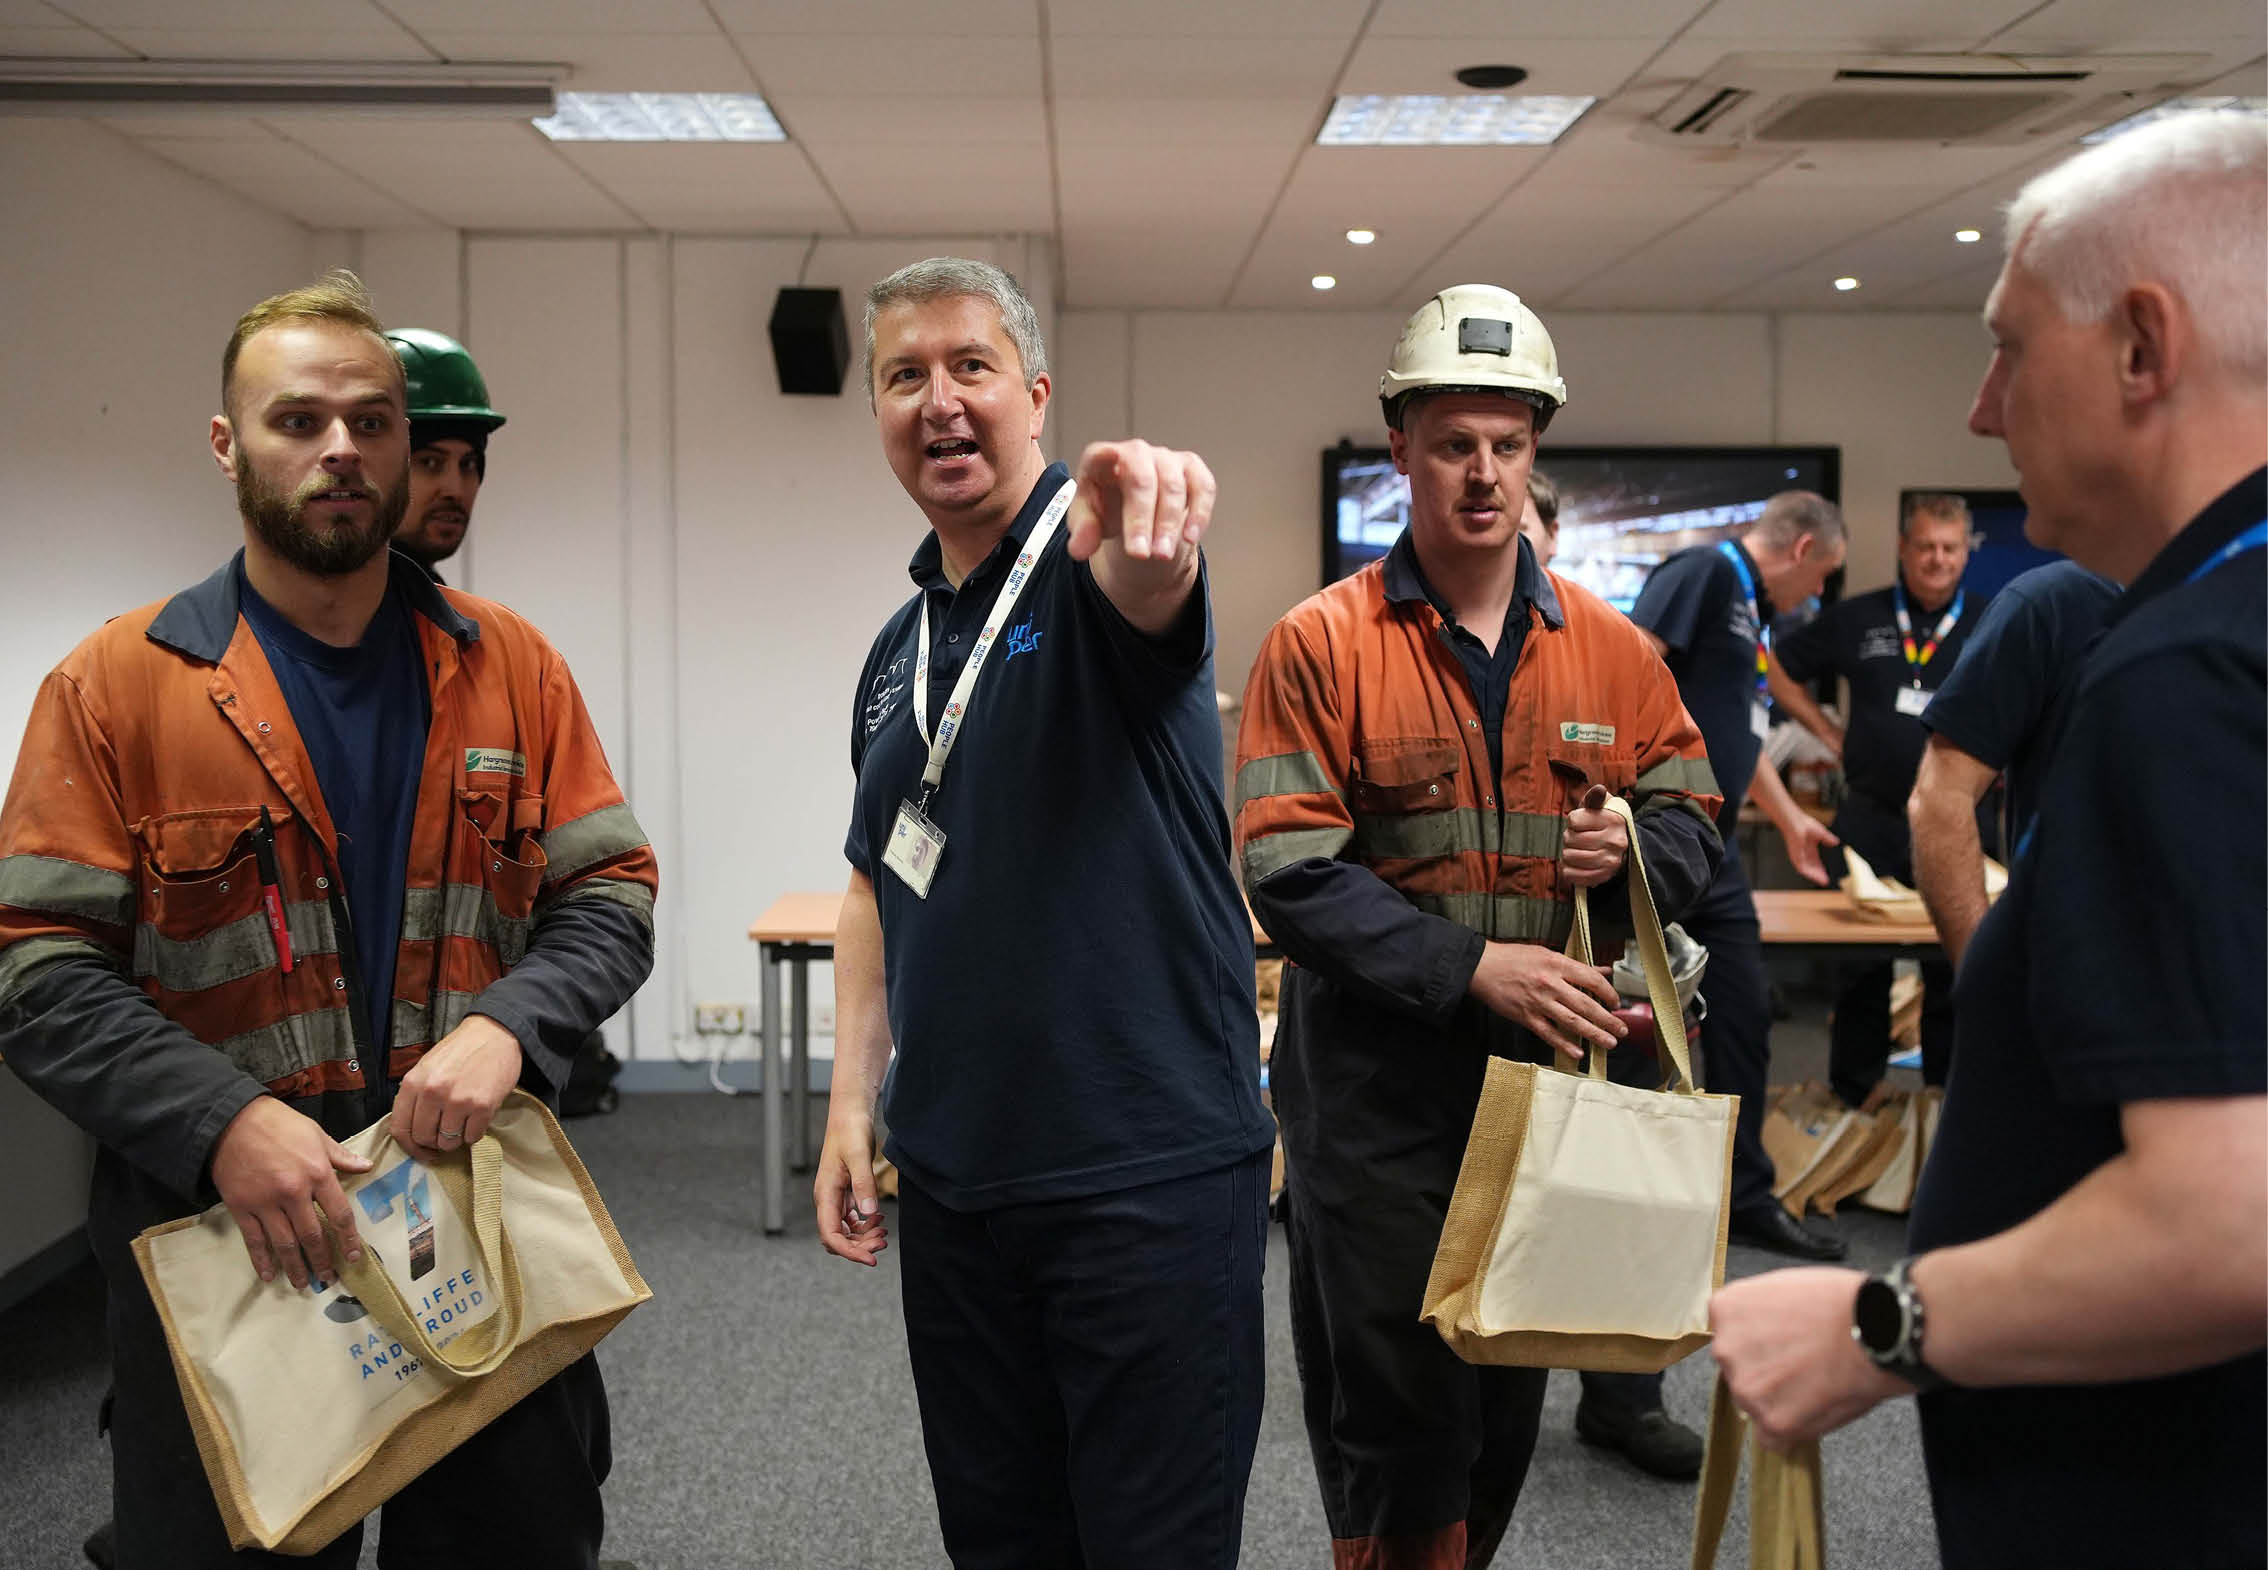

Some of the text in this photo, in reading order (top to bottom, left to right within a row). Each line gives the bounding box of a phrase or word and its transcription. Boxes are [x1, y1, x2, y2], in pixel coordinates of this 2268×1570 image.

[1009, 570, 1019, 583] HUB
[1009, 572, 1025, 596] PEOPLE
[973, 644, 982, 658] HUB
[973, 645, 987, 669] PEOPLE
[940, 720, 949, 735] HUB
[941, 723, 955, 749] PEOPLE
[362, 1290, 482, 1379] AND ROUD
